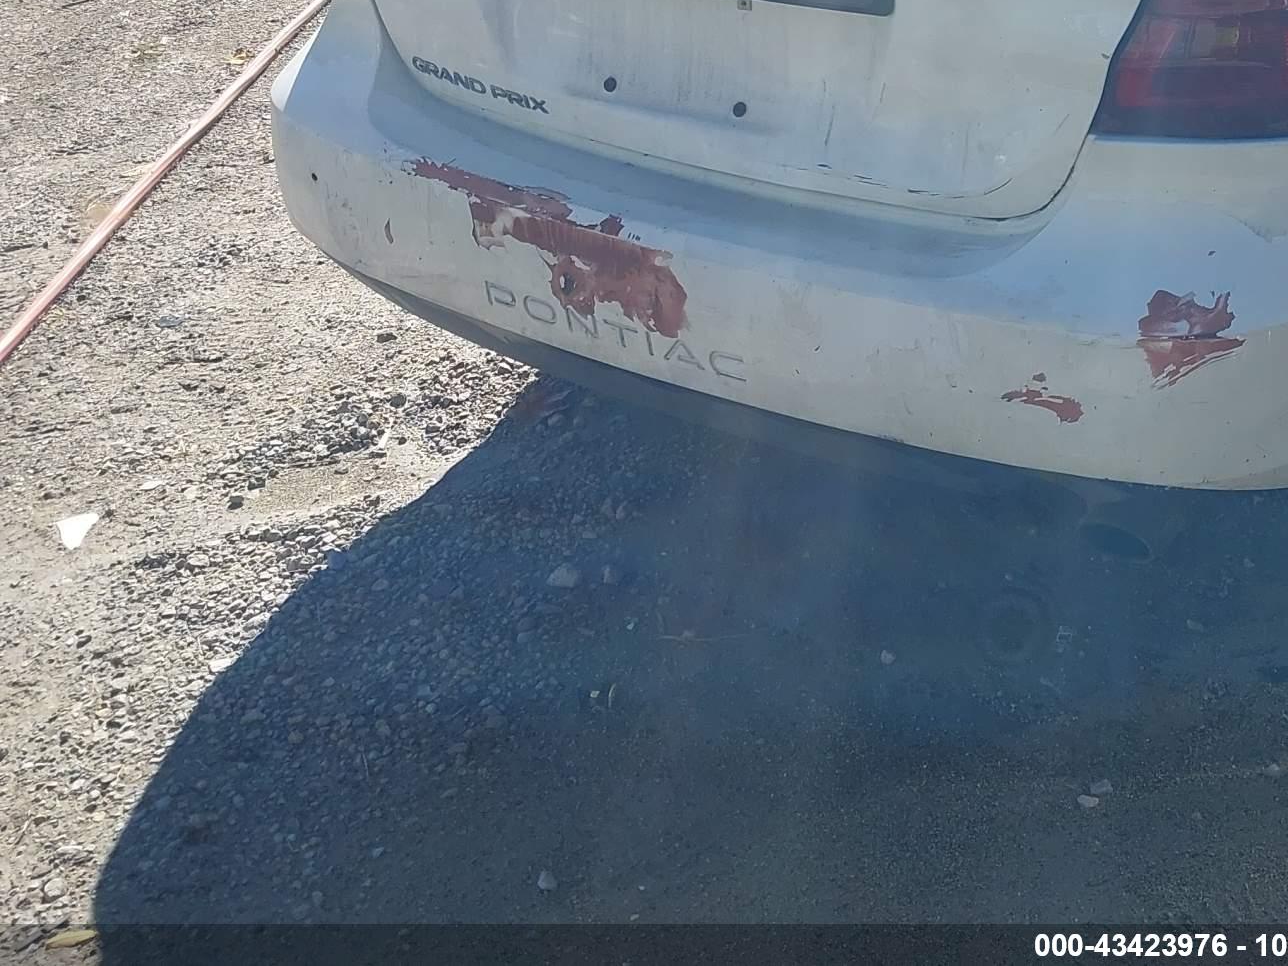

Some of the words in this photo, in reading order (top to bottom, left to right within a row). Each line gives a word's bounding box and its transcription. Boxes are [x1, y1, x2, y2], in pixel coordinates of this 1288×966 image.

[412, 56, 487, 95] GRAND
[490, 84, 550, 115] PRIX
[484, 280, 747, 382] PONTIAC
